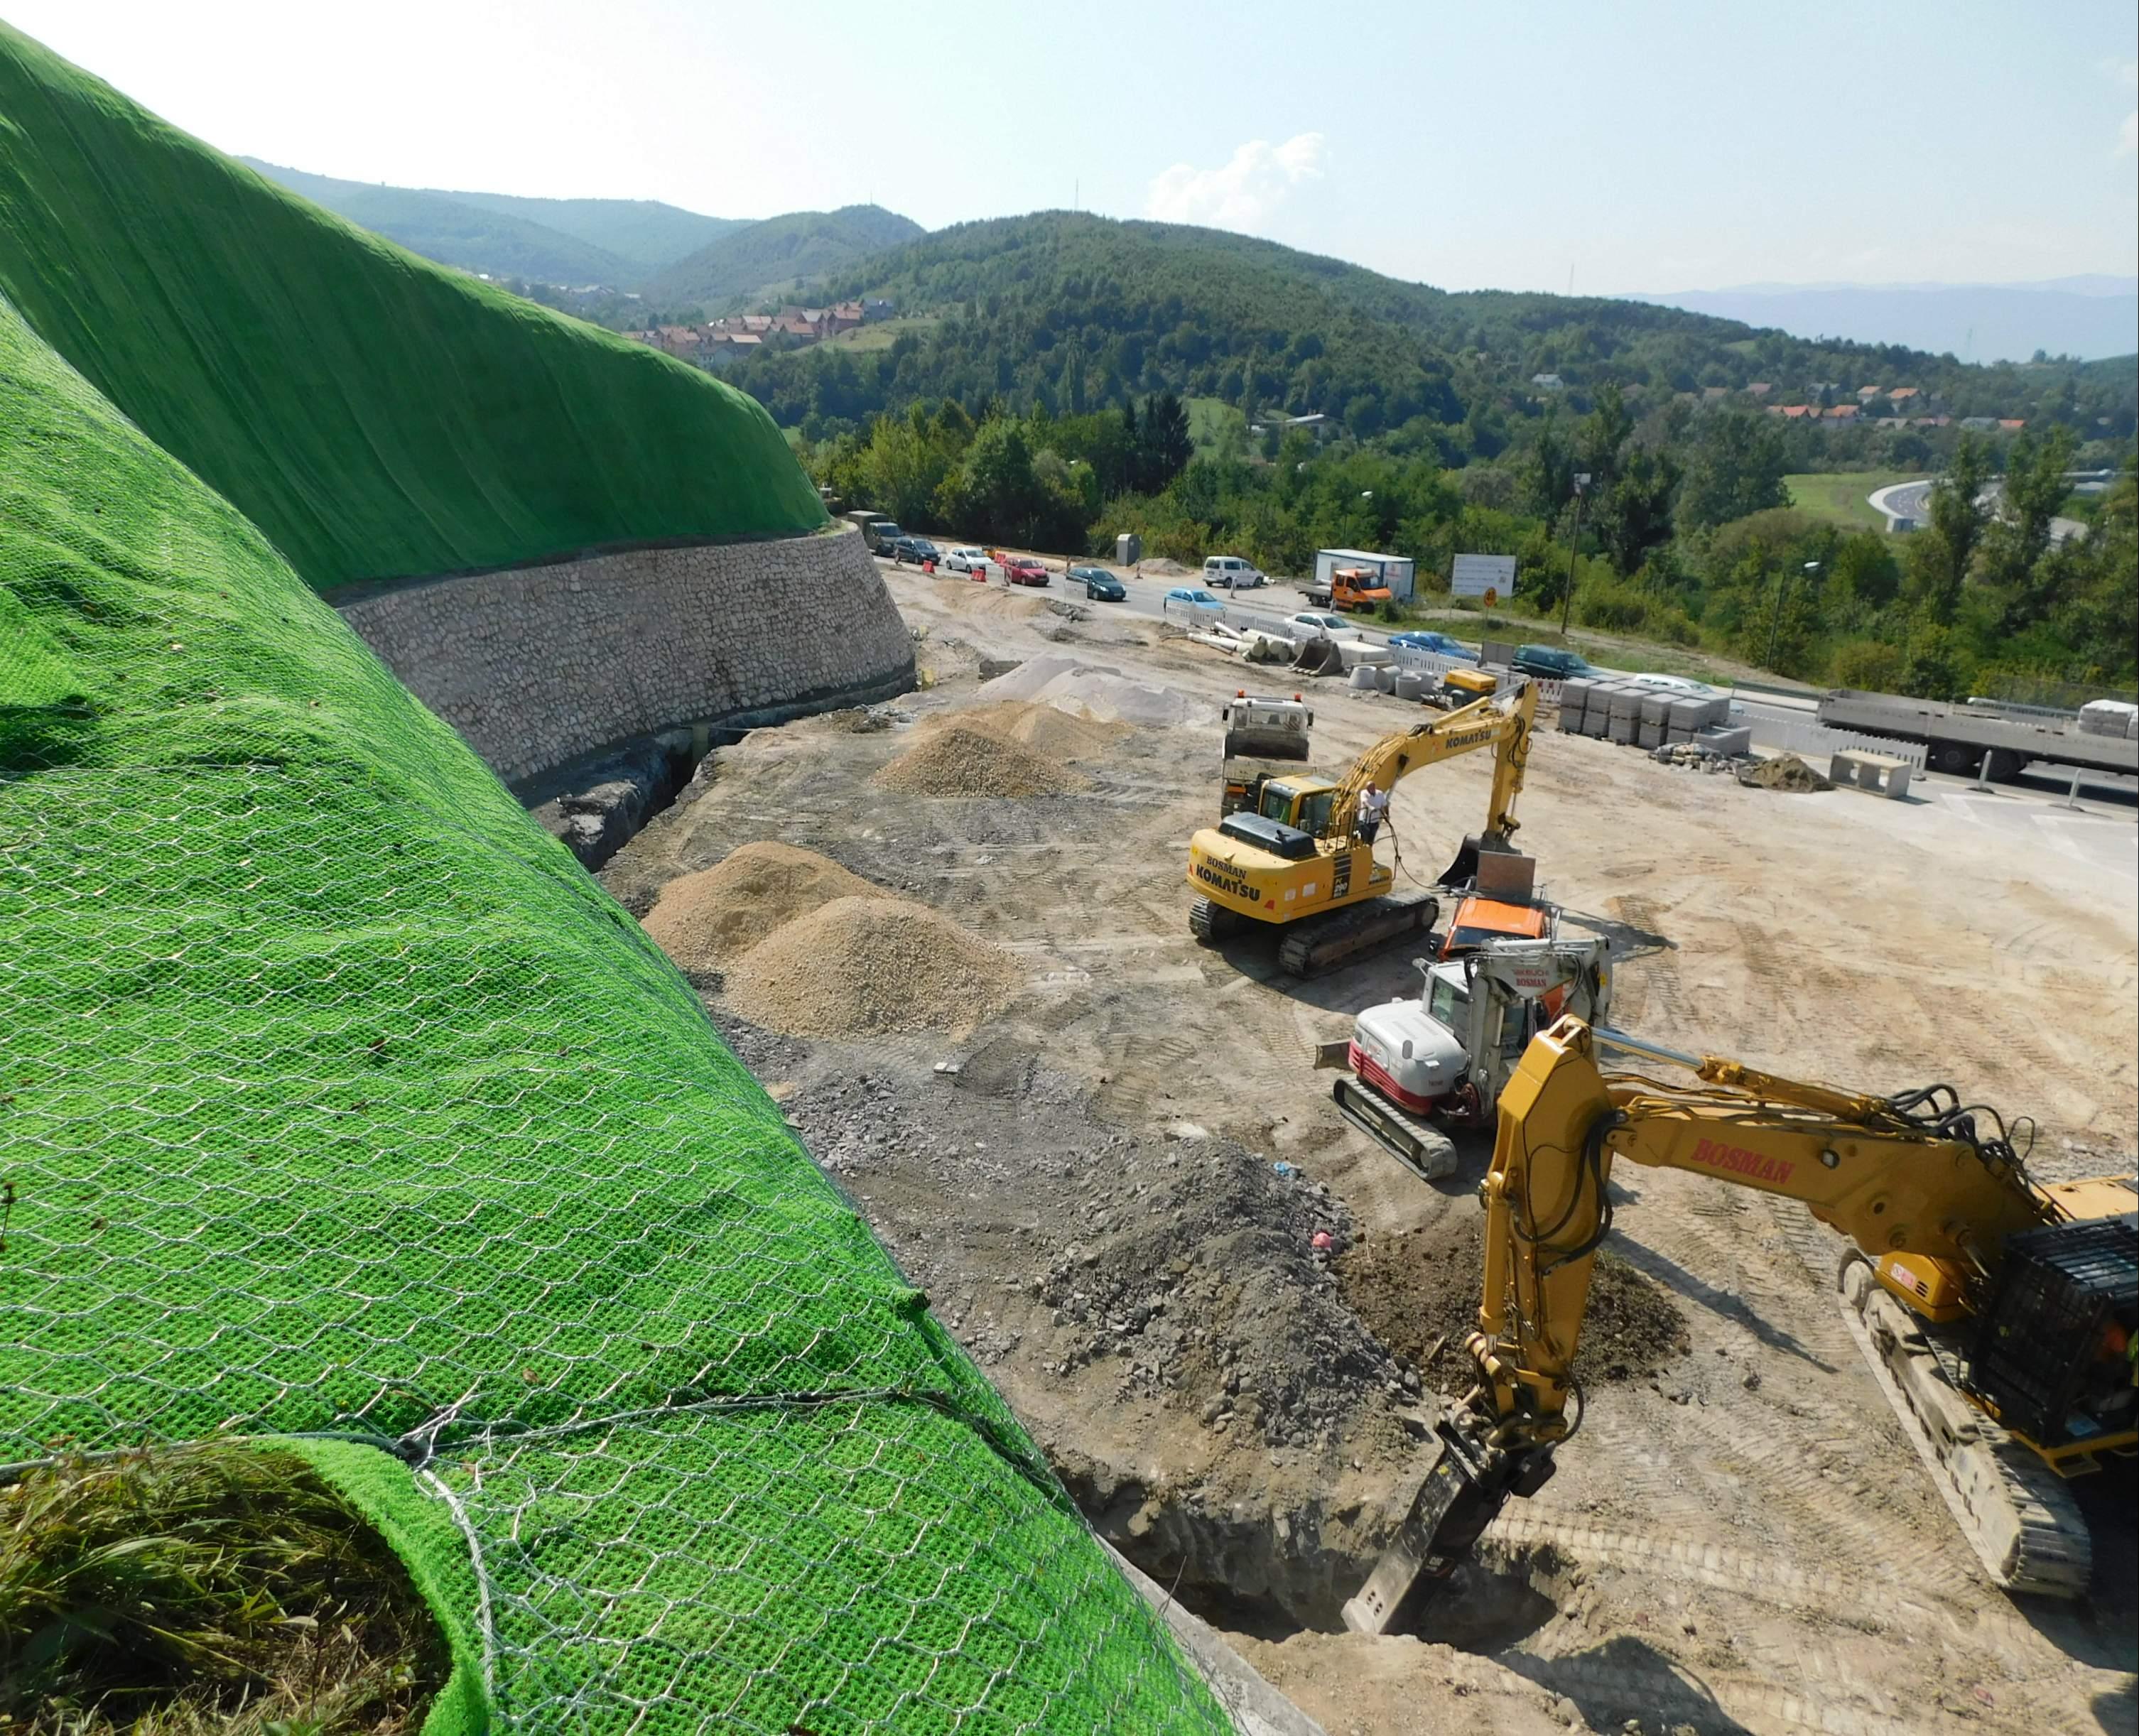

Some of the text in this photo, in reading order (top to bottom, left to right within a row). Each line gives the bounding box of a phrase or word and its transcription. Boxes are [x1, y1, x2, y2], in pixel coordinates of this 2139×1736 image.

[1446, 729, 1491, 749] KOMATSU
[1206, 855, 1247, 879] BOSMAN
[1196, 864, 1261, 901] KOMATSU
[1516, 978, 1547, 987] BOSMAN
[1690, 1138, 1796, 1185] BOSMAN
